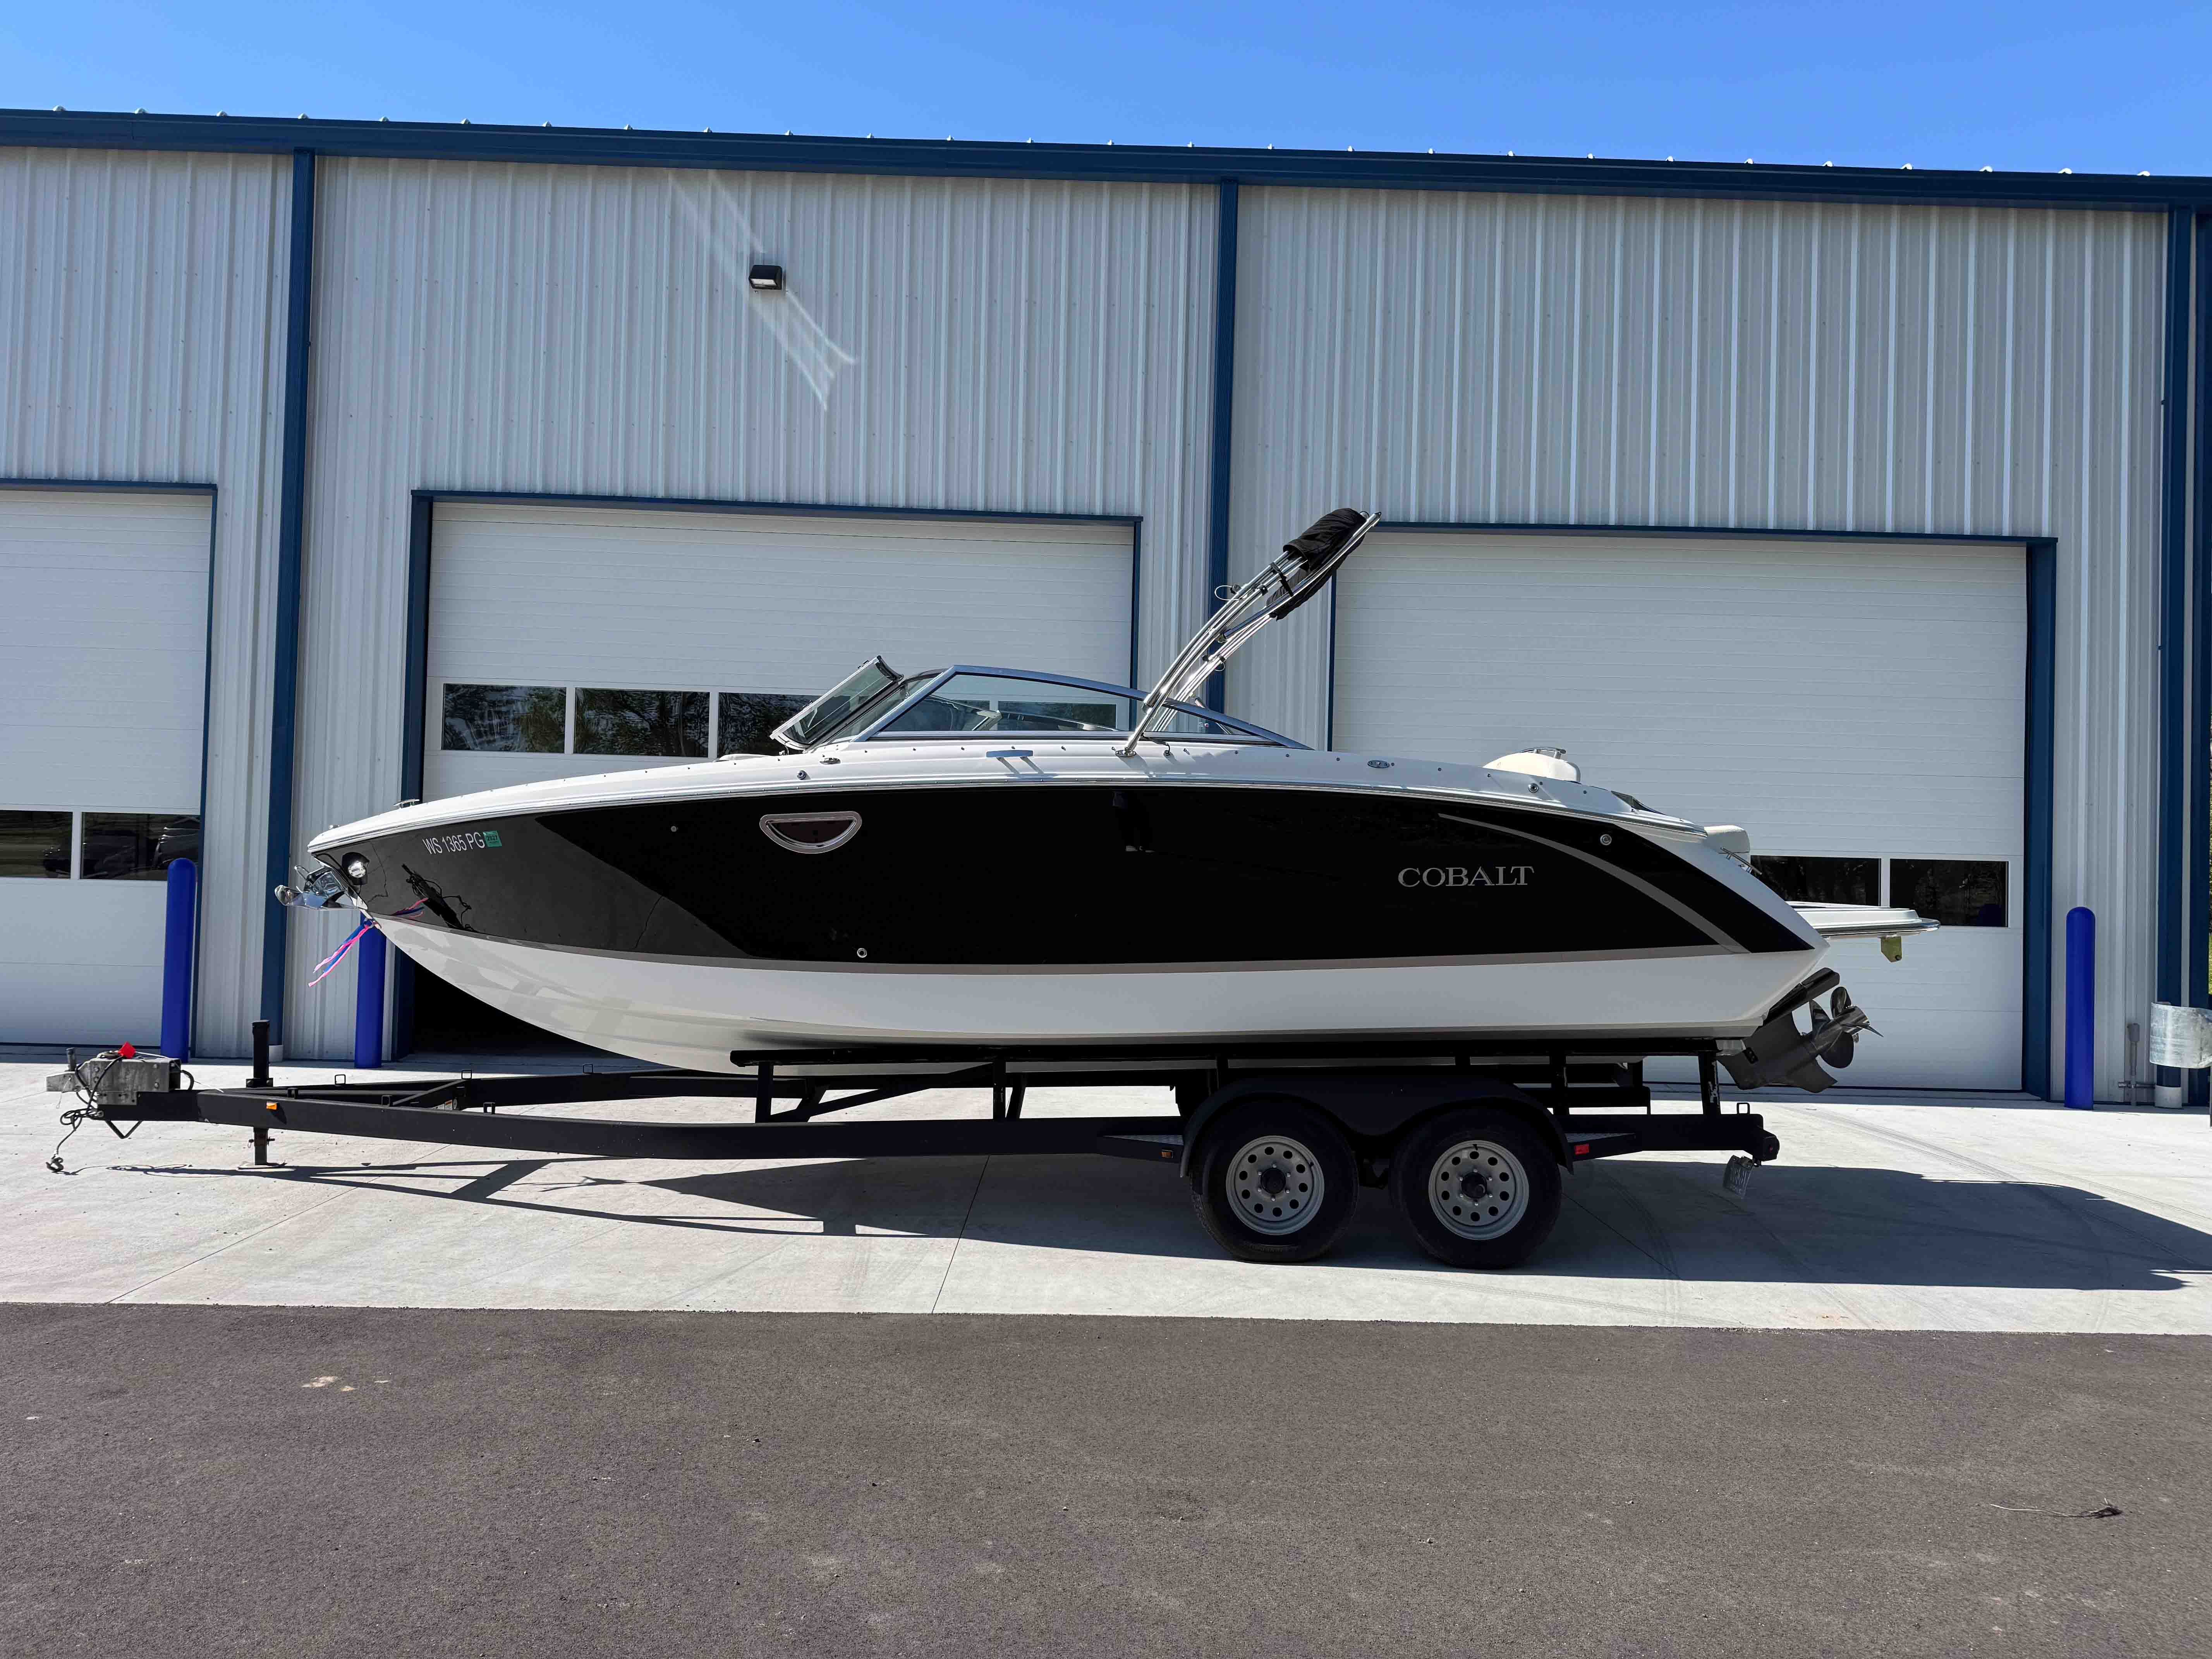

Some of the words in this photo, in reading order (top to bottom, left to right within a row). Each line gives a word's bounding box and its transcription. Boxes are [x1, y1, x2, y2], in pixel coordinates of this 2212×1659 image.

[422, 838, 442, 854] WS
[442, 835, 467, 852] 1365
[465, 832, 485, 849] PG
[1398, 866, 1534, 887] COBALT
